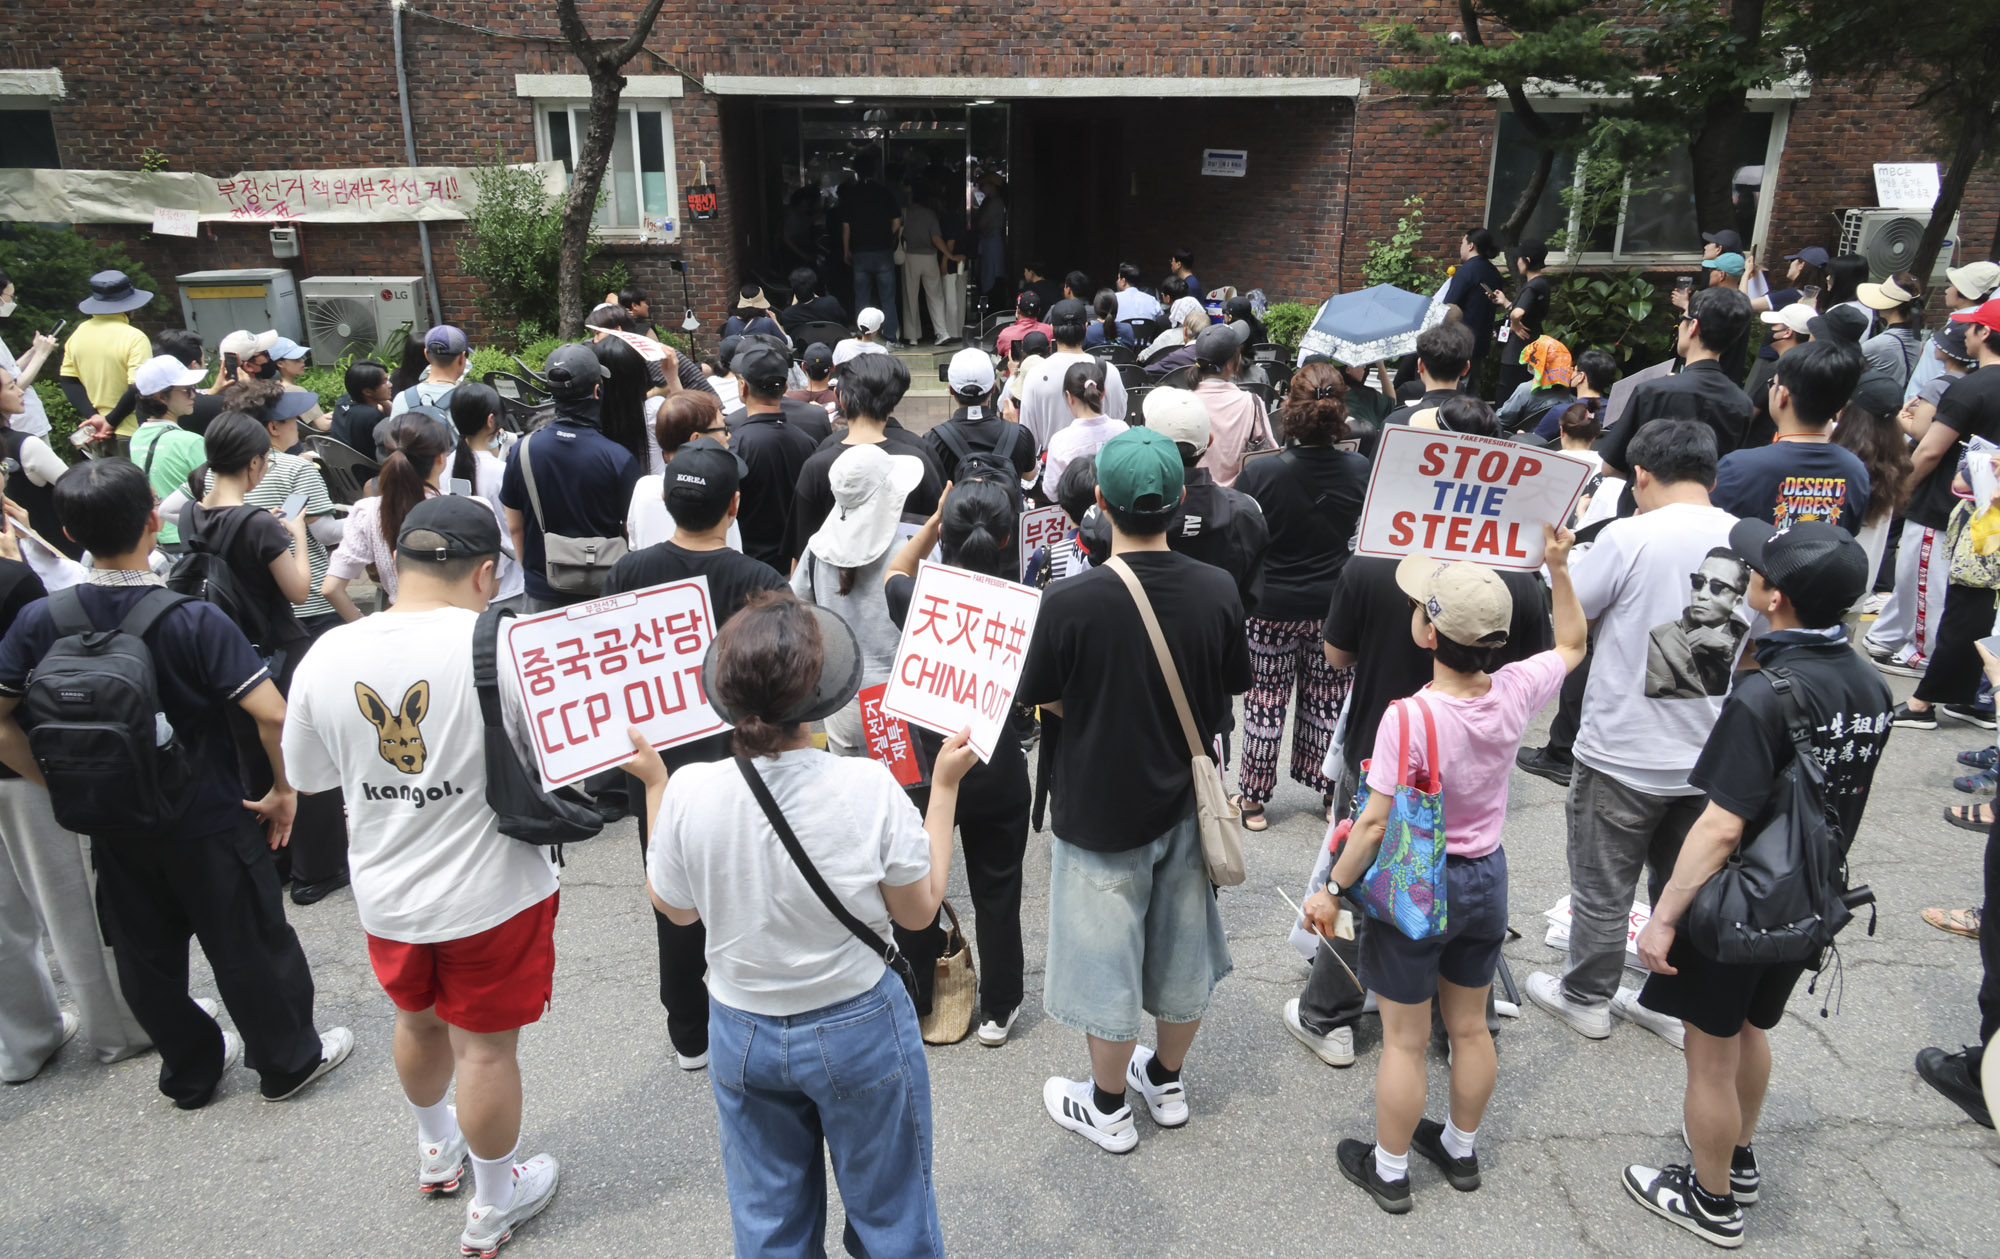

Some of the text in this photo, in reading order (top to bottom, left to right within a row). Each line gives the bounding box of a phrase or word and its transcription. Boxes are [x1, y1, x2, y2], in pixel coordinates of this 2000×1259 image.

[217, 174, 307, 206] 부정선거
[687, 193, 717, 212] 부정선거
[394, 291, 408, 300] LG
[1460, 434, 1518, 449] FAKE PRESIDENT
[677, 474, 707, 485] KOREA
[1418, 442, 1542, 487] STOP
[1433, 480, 1508, 516] THE
[1783, 477, 1846, 497] DESERT
[1788, 496, 1833, 515] VIBES
[1025, 516, 1072, 550] 부정
[1388, 511, 1527, 559] STEAL
[585, 598, 618, 613] 부정선거
[912, 594, 1027, 672] 天灭中共
[522, 609, 703, 696] 중국공산당
[901, 653, 1012, 725] CHINA OUT
[536, 664, 708, 754] CCP OUT
